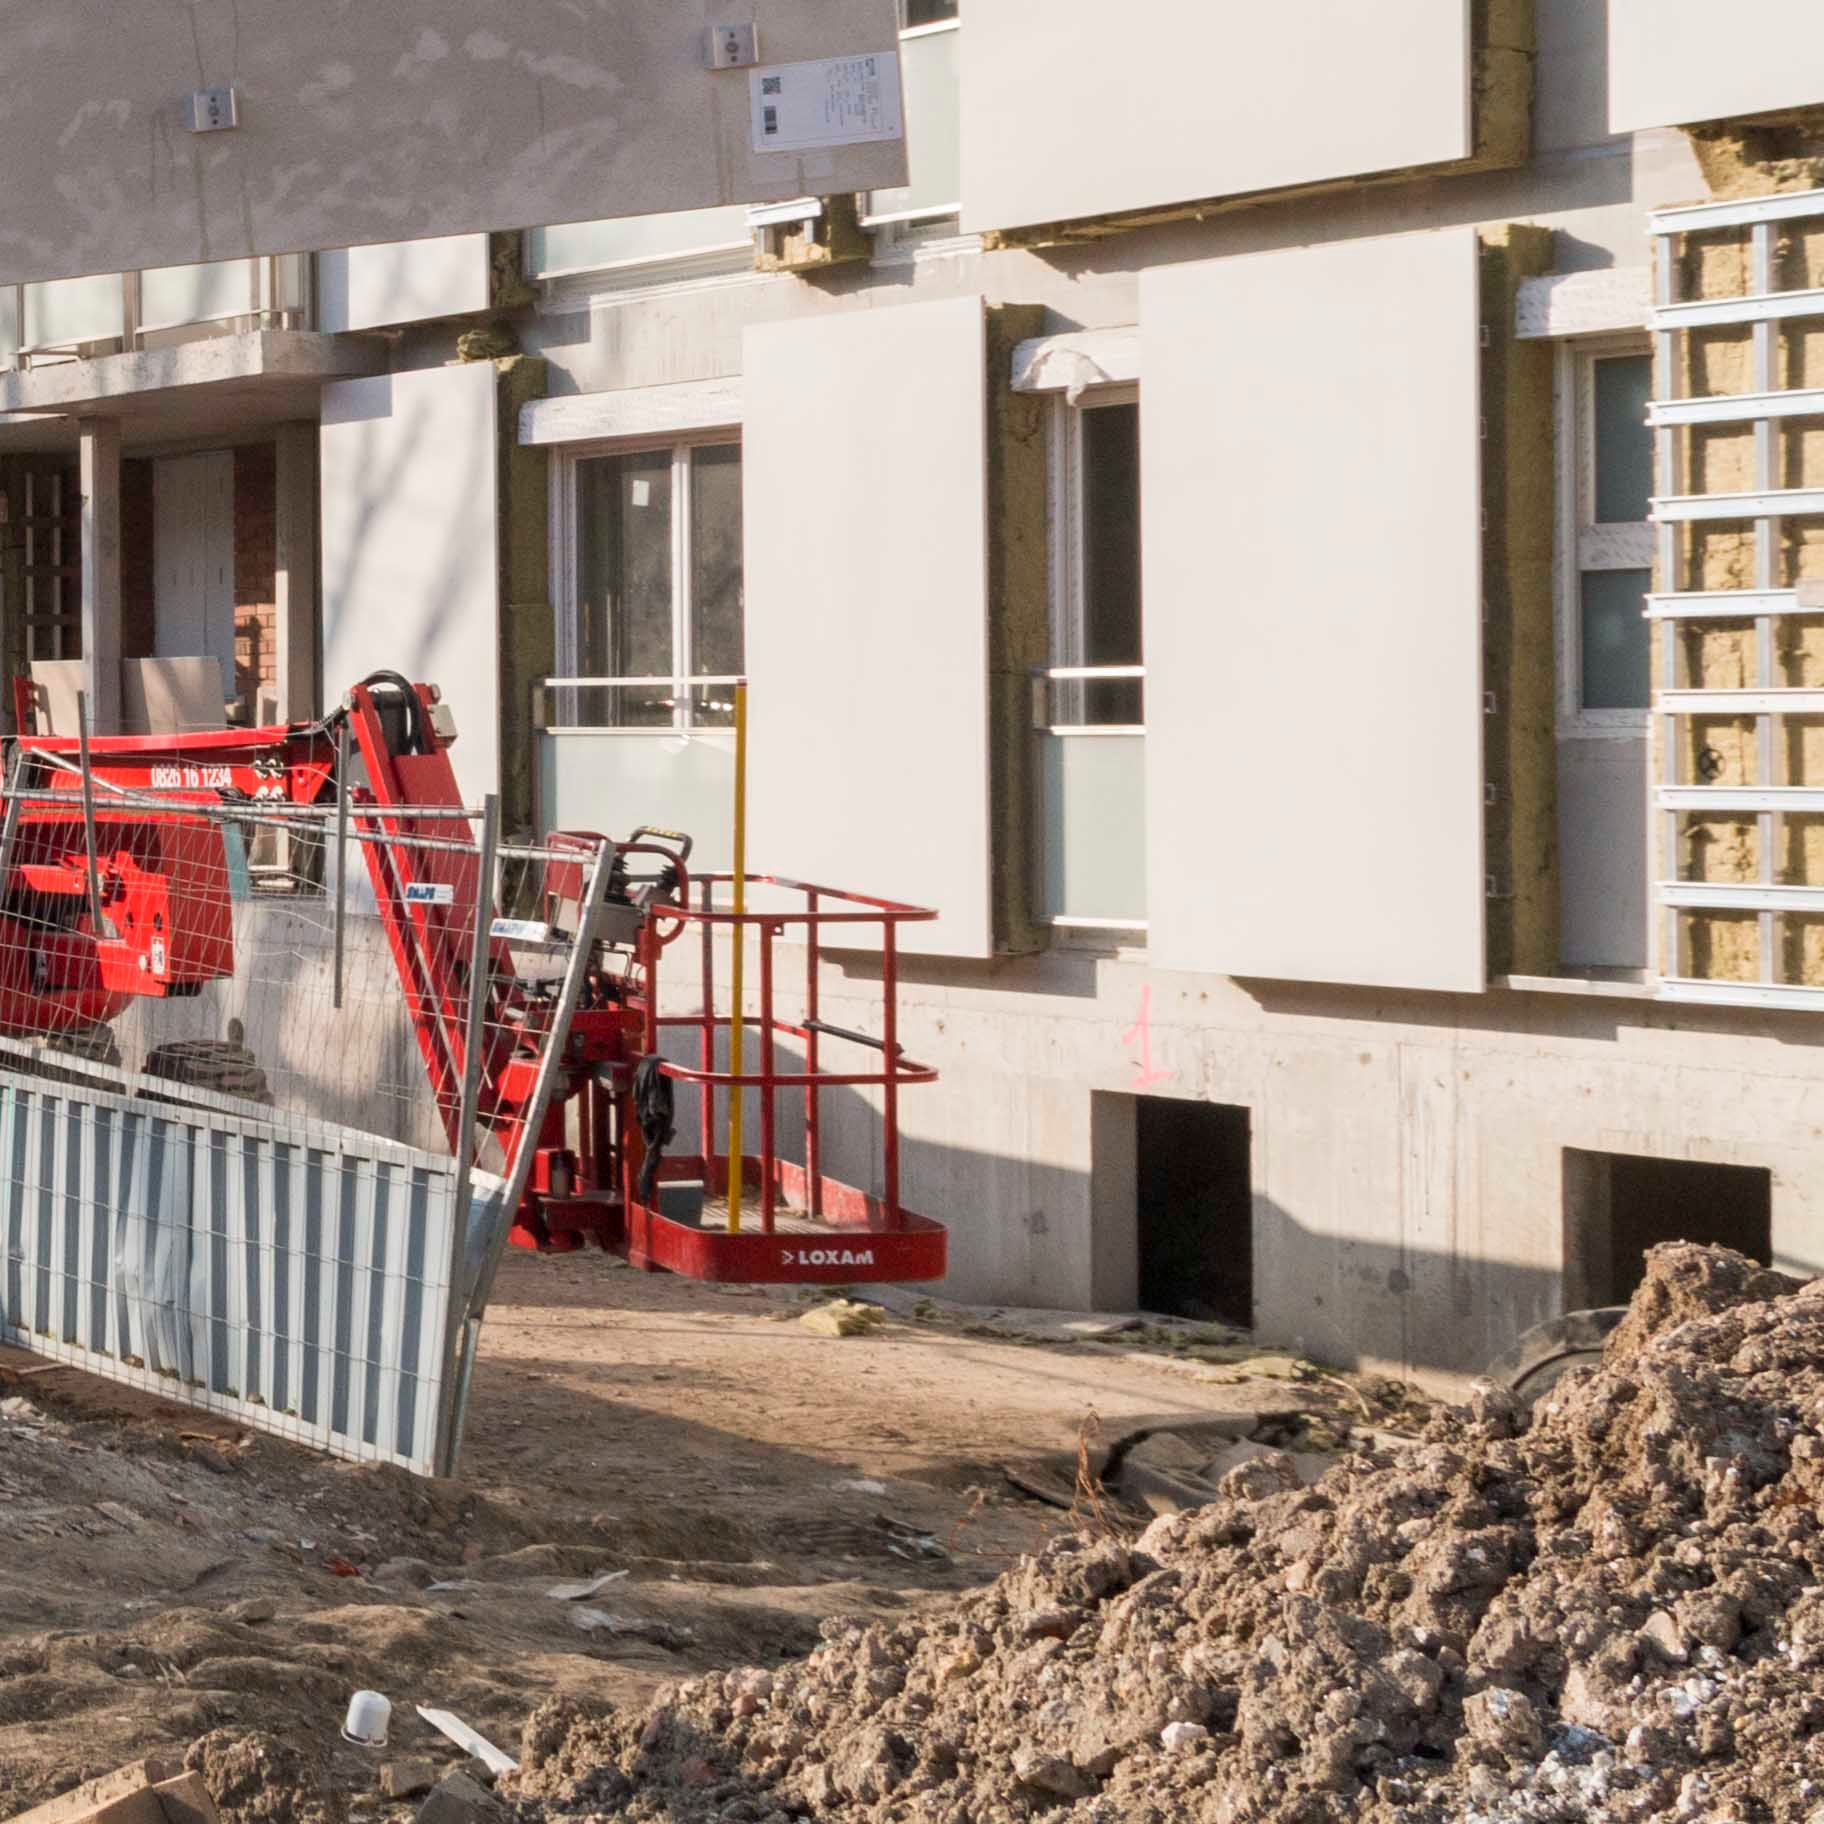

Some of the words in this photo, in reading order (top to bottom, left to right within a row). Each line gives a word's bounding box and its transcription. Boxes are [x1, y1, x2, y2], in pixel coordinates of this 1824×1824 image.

[201, 763, 232, 787] 1234
[1120, 981, 1178, 1089] 1
[798, 1249, 875, 1265] LOXAM
